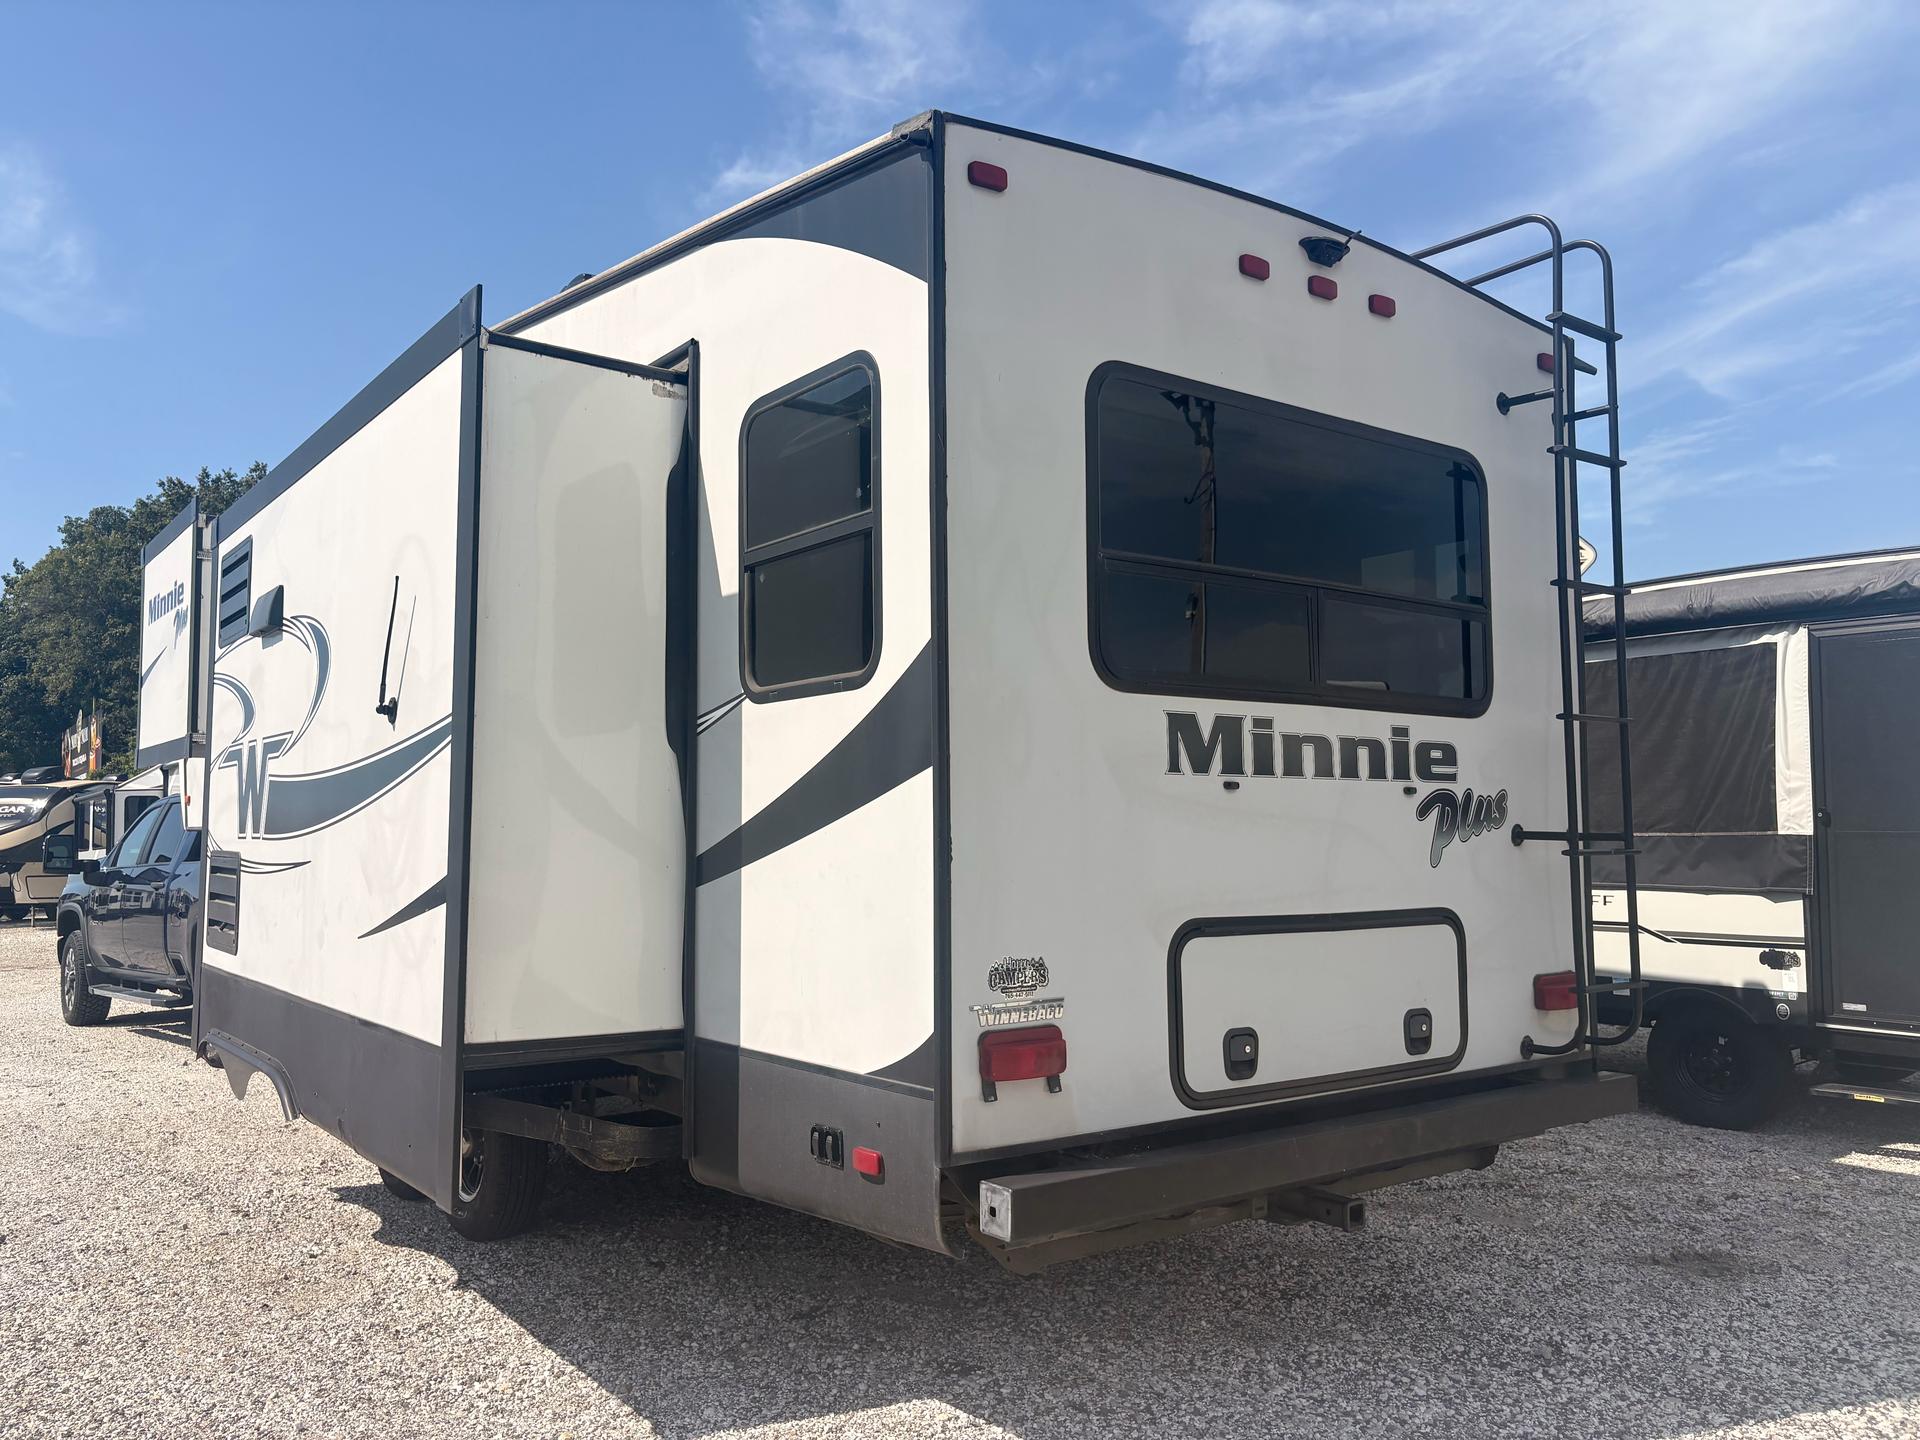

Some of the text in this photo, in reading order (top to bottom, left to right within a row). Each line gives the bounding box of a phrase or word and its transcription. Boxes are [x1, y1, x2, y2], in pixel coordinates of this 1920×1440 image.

[148, 579, 184, 626] Minnie
[1163, 710, 1459, 783] Minnie
[1416, 788, 1508, 868] Plus
[989, 968, 1047, 989] CAMPERS
